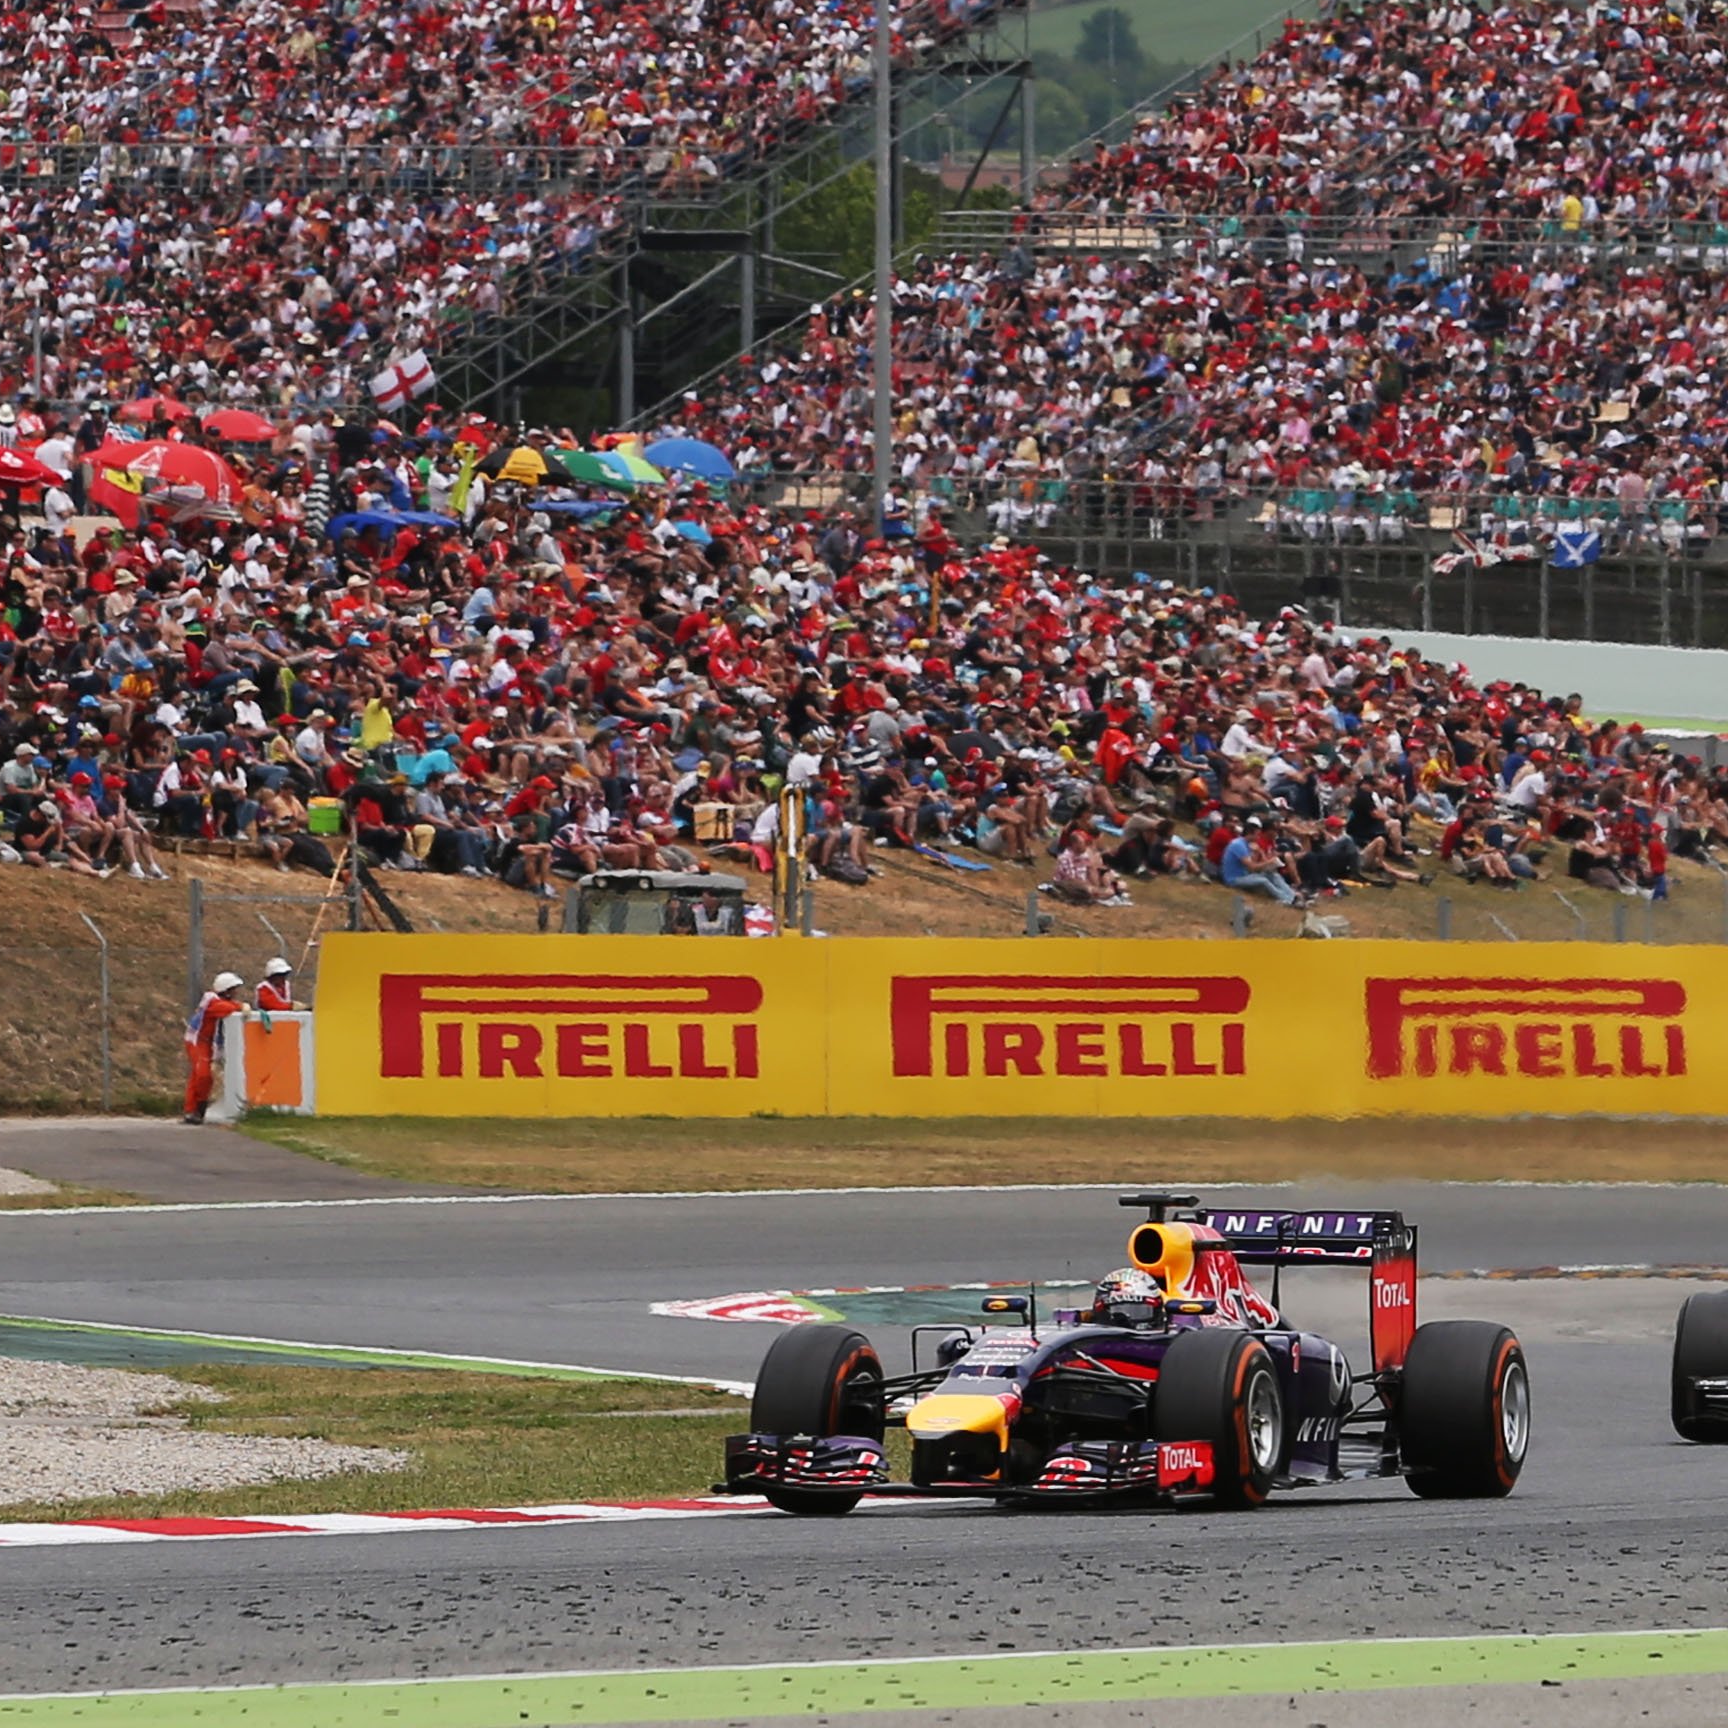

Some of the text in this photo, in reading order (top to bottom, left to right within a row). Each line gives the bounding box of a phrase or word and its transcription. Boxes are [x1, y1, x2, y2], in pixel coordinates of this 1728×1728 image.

[379, 973, 763, 1079] PIRELLI
[891, 975, 1251, 1077] PIRELLI
[1365, 976, 1687, 1080] PIRELLI
[1374, 1278, 1410, 1308] TOTAL
[1162, 1446, 1203, 1470] TOTAL
